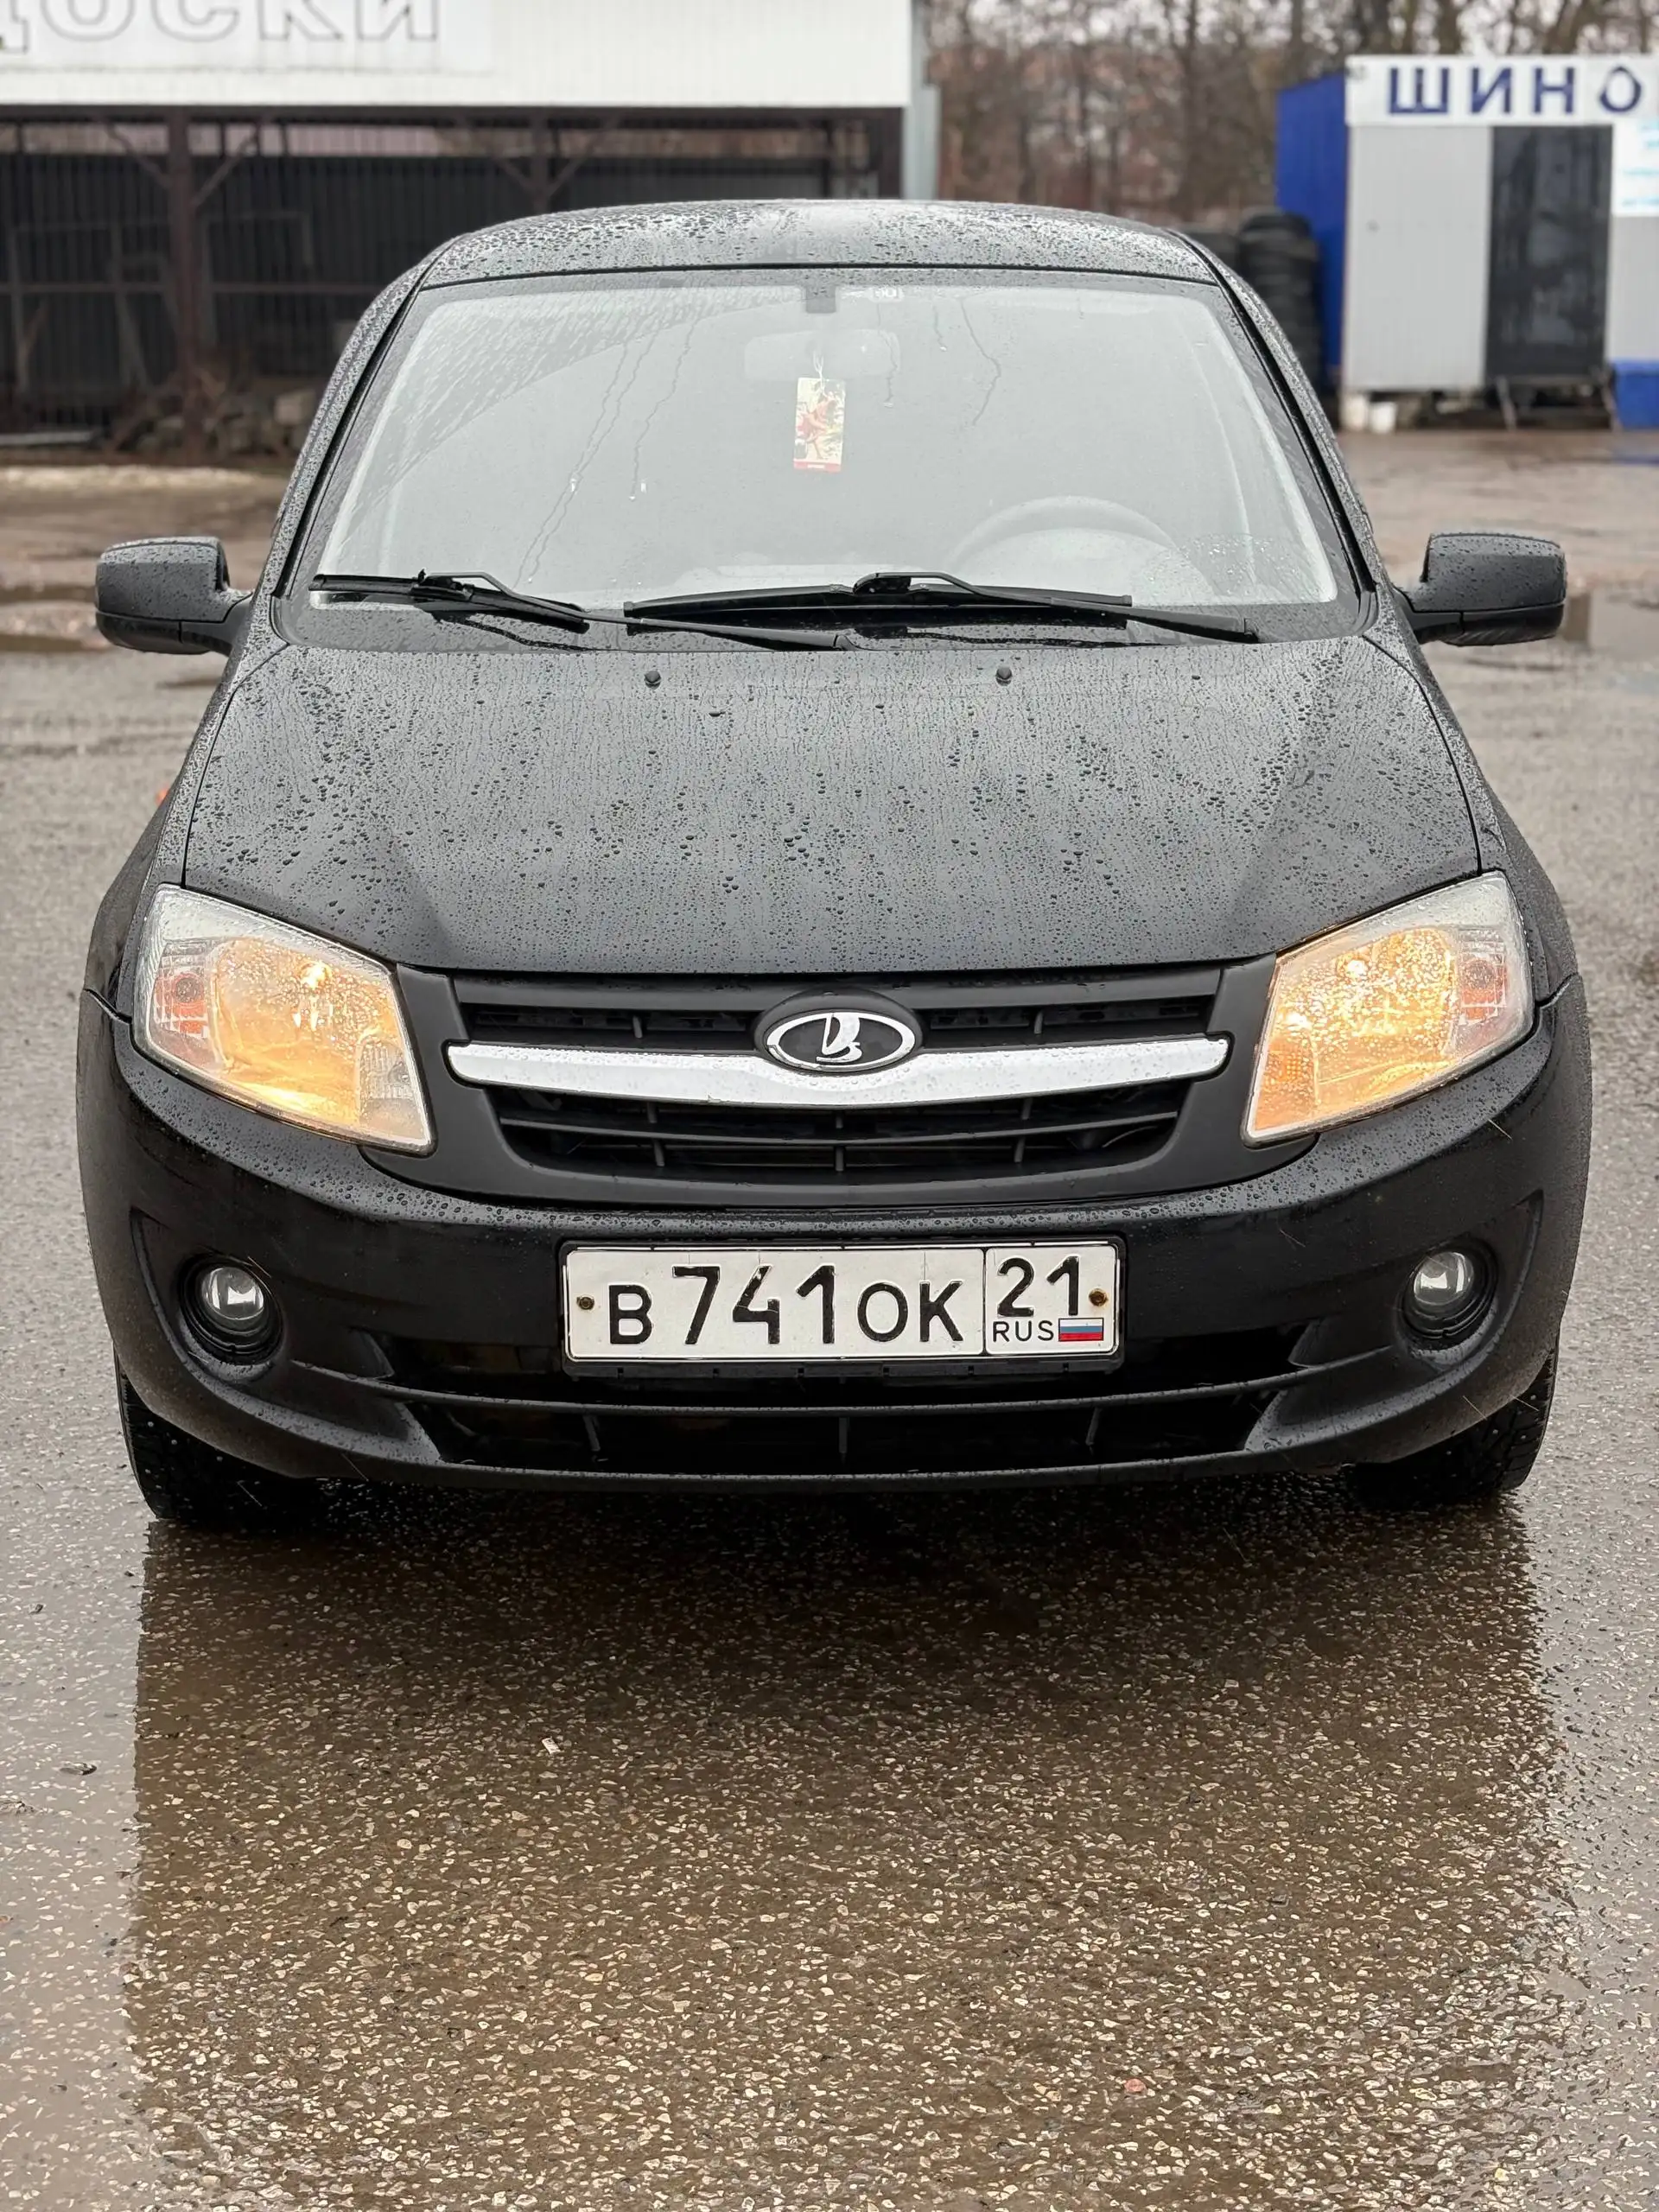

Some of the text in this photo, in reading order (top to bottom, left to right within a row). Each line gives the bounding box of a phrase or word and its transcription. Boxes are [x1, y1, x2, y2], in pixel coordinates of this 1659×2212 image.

[1389, 66, 1643, 114] ШИНО
[996, 1255, 1080, 1318] 21
[993, 1319, 1055, 1343] RUS
